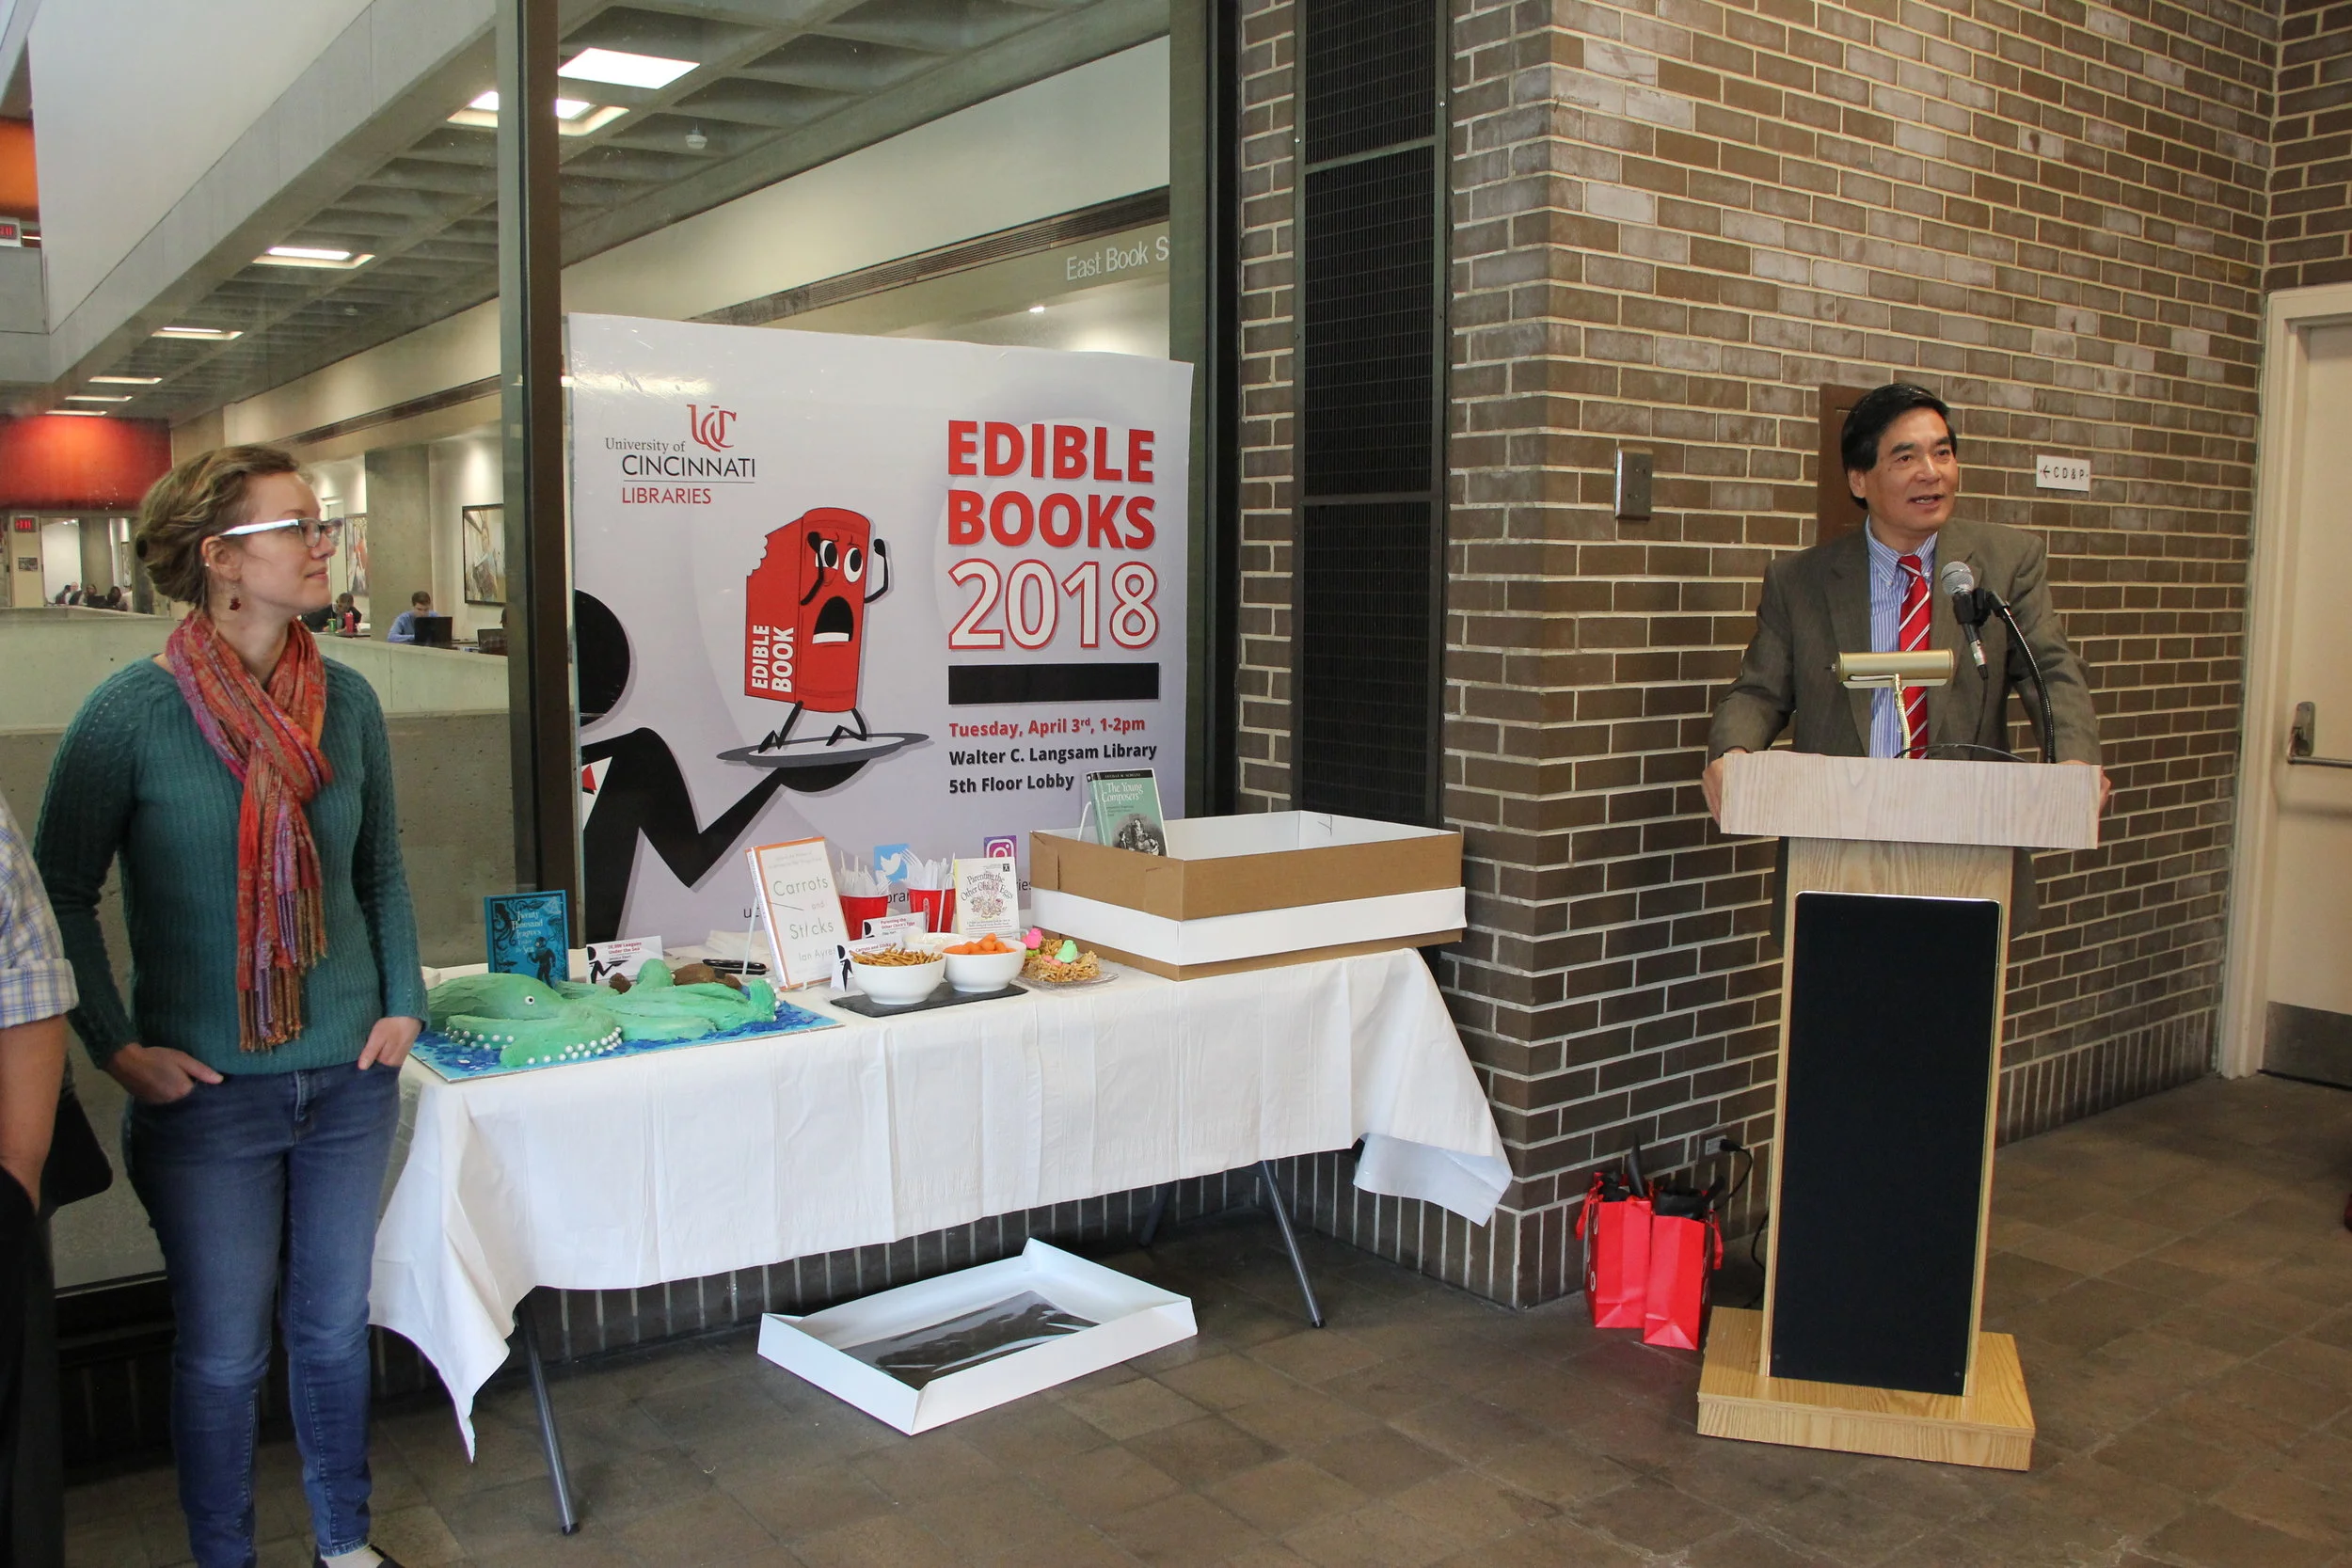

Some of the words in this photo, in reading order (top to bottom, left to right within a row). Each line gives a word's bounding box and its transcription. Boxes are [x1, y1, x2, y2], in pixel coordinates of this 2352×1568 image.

[1067, 251, 1102, 281] East
[1106, 241, 1149, 273] Book
[606, 437, 669, 454] University
[673, 441, 686, 452] of
[948, 420, 1155, 483] EDIBLE
[622, 454, 755, 478] CINCINNATI
[622, 487, 712, 505] LIBRARIES
[948, 489, 1156, 550] BOOKS
[948, 558, 1159, 650] 2018
[752, 625, 770, 689] EDIBLE
[771, 626, 794, 693] BOOK
[949, 721, 1024, 739] Tuesday,
[1027, 719, 1067, 738] April
[1071, 717, 1095, 735] 3rd,
[1100, 717, 1146, 735] 1-2pm
[949, 749, 1006, 766] Walter
[1010, 749, 1025, 763] C.
[1029, 747, 1099, 765] Langsam
[1104, 743, 1157, 761] Library
[949, 779, 977, 794] 5th
[982, 775, 1023, 792] Floor
[1027, 773, 1074, 791] Lobby
[1106, 782, 1120, 793] The
[1121, 782, 1143, 795] Young
[773, 876, 829, 896] Carrots
[967, 872, 994, 884] Parenting
[994, 872, 1005, 883] the
[961, 887, 977, 901] Other
[977, 881, 999, 892] Chick's
[999, 884, 1013, 899] Eggs
[811, 900, 826, 911] and
[516, 911, 539, 922] Twenty
[789, 917, 834, 940] Sticks
[799, 952, 812, 961] Ian
